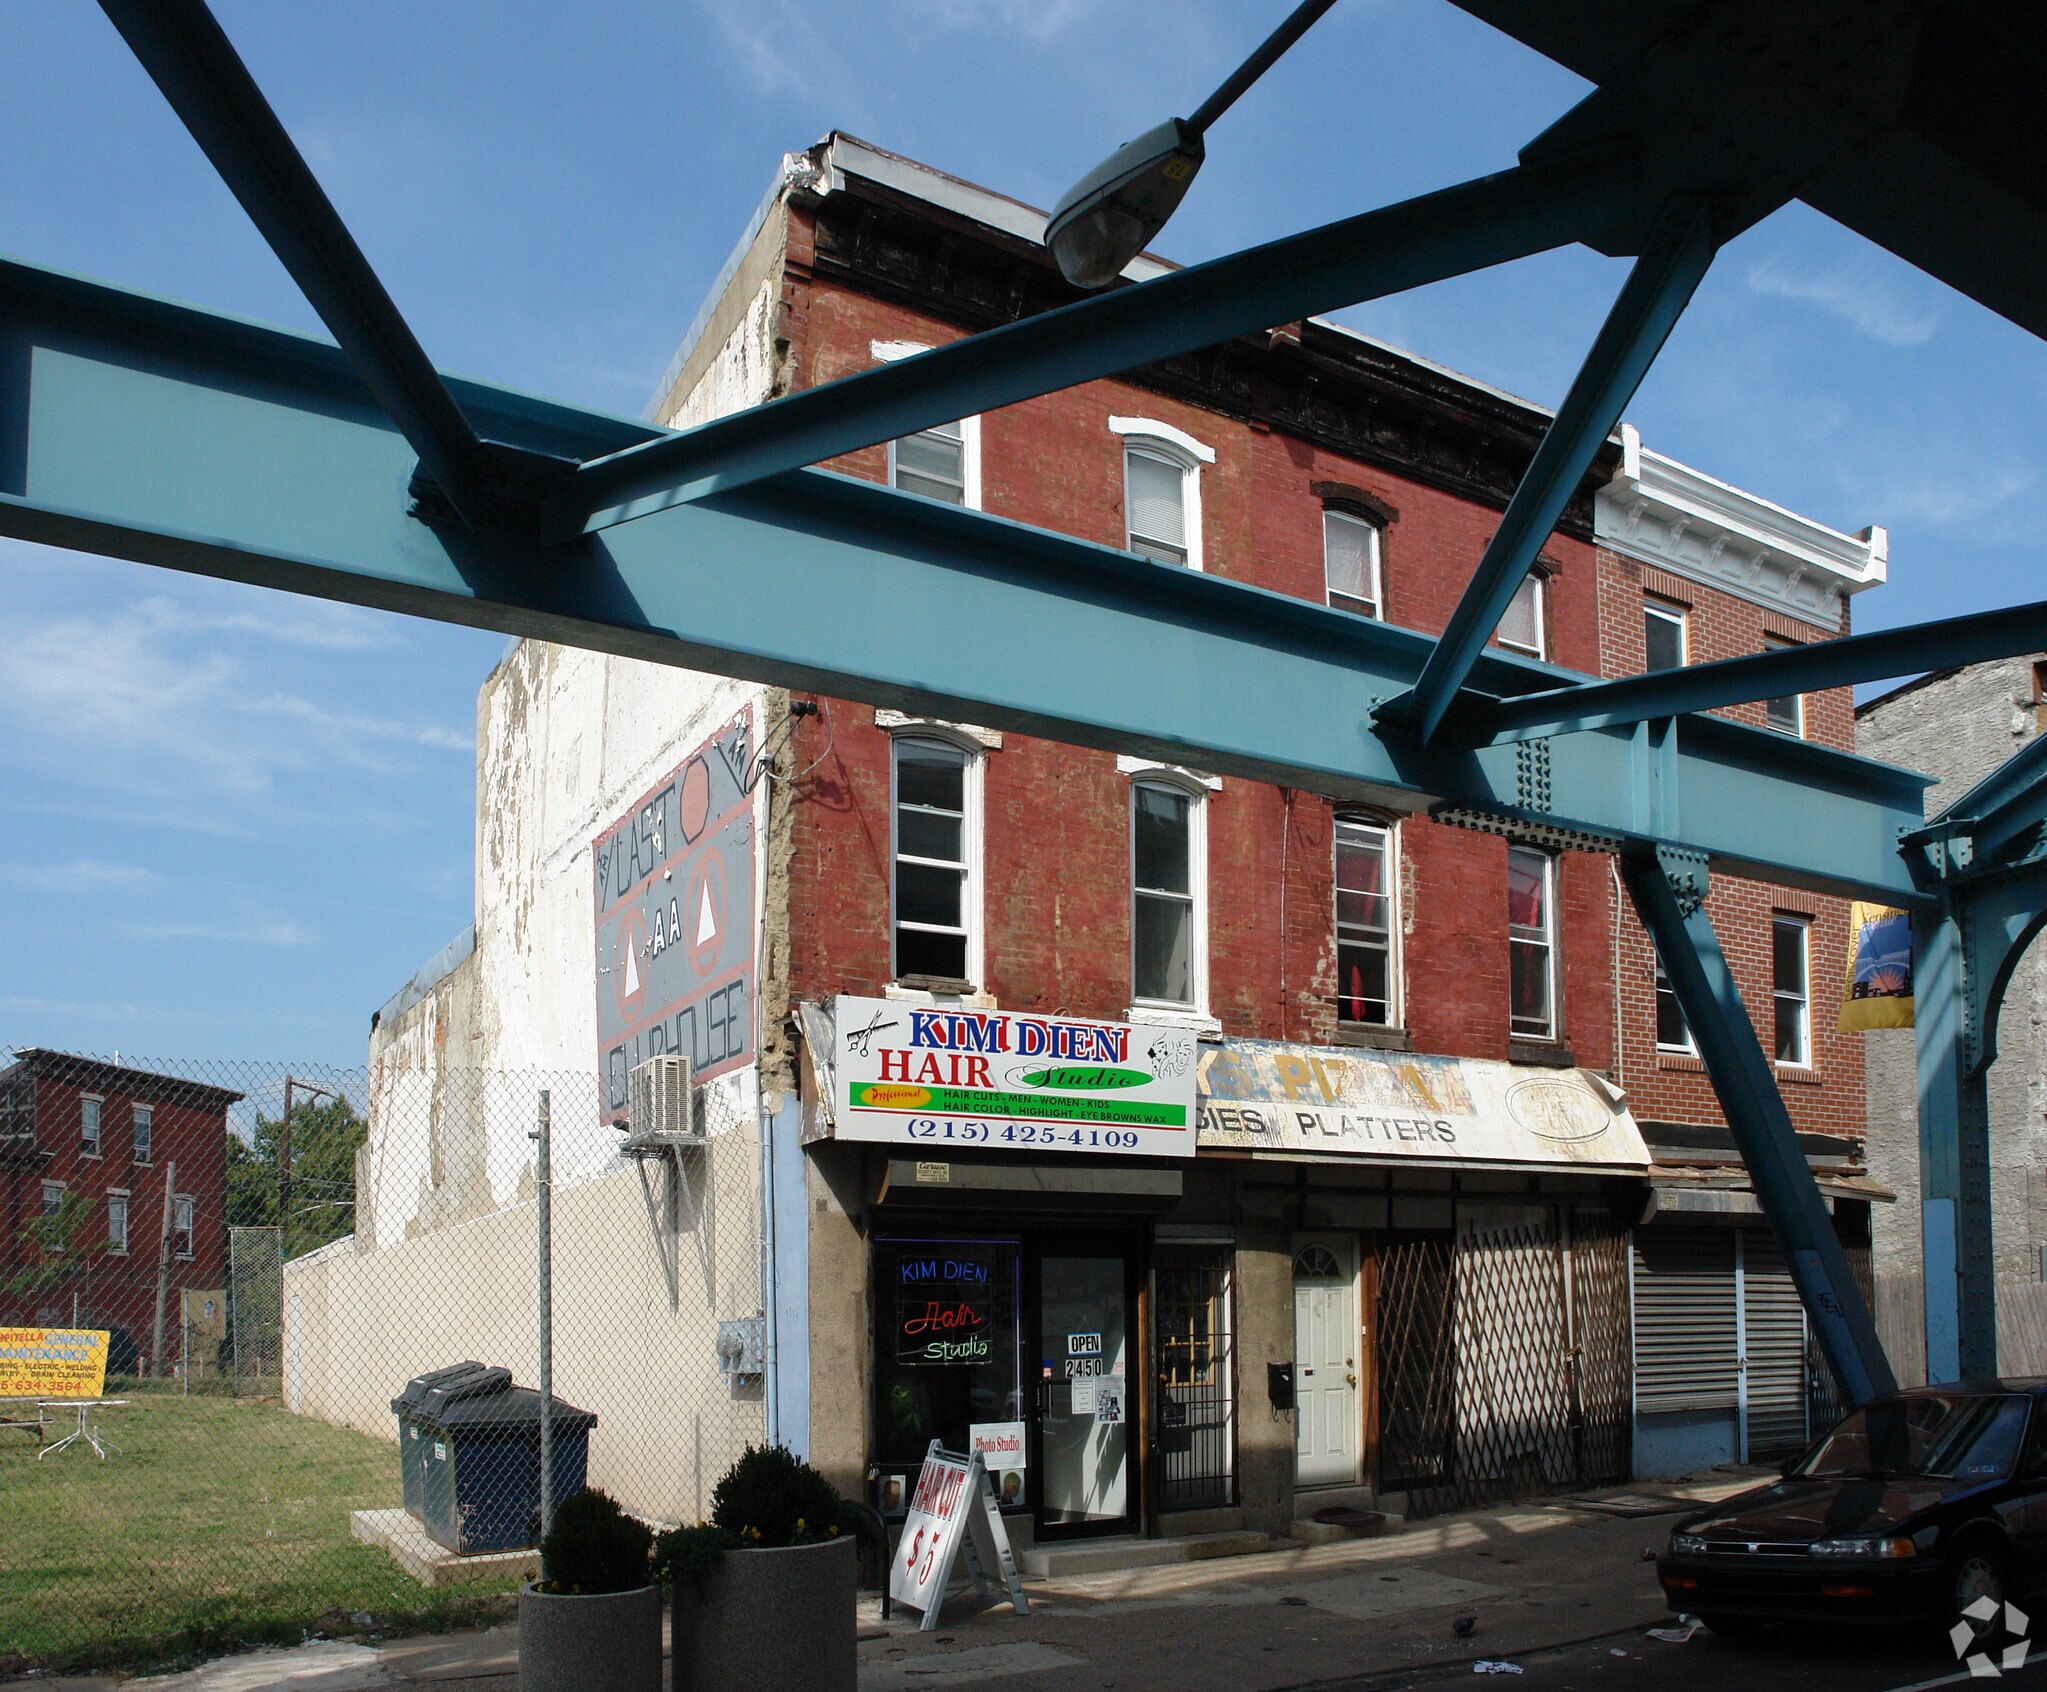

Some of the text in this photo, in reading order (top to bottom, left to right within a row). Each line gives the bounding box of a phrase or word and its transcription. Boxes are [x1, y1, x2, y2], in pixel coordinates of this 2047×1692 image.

[617, 782, 676, 897] LAST
[652, 896, 682, 960] AA
[909, 1008, 1131, 1063] KIM DIEN
[877, 1048, 994, 1088] HAIR
[1005, 1062, 1132, 1090] Studio
[1274, 1053, 1442, 1112] PIZ
[871, 1087, 921, 1104] Professional
[944, 1090, 970, 1100] HAIR
[973, 1092, 1000, 1101] CUTS
[1009, 1095, 1031, 1103] MEN
[1040, 1096, 1080, 1107] WOMEN
[1087, 1100, 1110, 1109] KIDS
[944, 1102, 970, 1112] HAIR
[973, 1104, 1010, 1115] COLOR
[1019, 1107, 1073, 1118] HIGHLIGHT
[1081, 1111, 1098, 1120] EYE
[1101, 1112, 1142, 1124] BROWNS
[1144, 1115, 1167, 1124] WAX
[908, 1118, 1139, 1148] (215) 425-4109
[1295, 1112, 1456, 1144] PLATTERS
[919, 1161, 947, 1170] Caruso
[901, 1260, 988, 1284] KIM DIEN
[45, 1333, 99, 1346] GENERAL
[923, 1335, 988, 1361] Studio
[1071, 1335, 1099, 1352] OPEN
[57, 1371, 96, 1379] CLEANING
[1066, 1359, 1102, 1378] 2450
[48, 1381, 82, 1391] 3564
[975, 1434, 1020, 1453] Photo Studio
